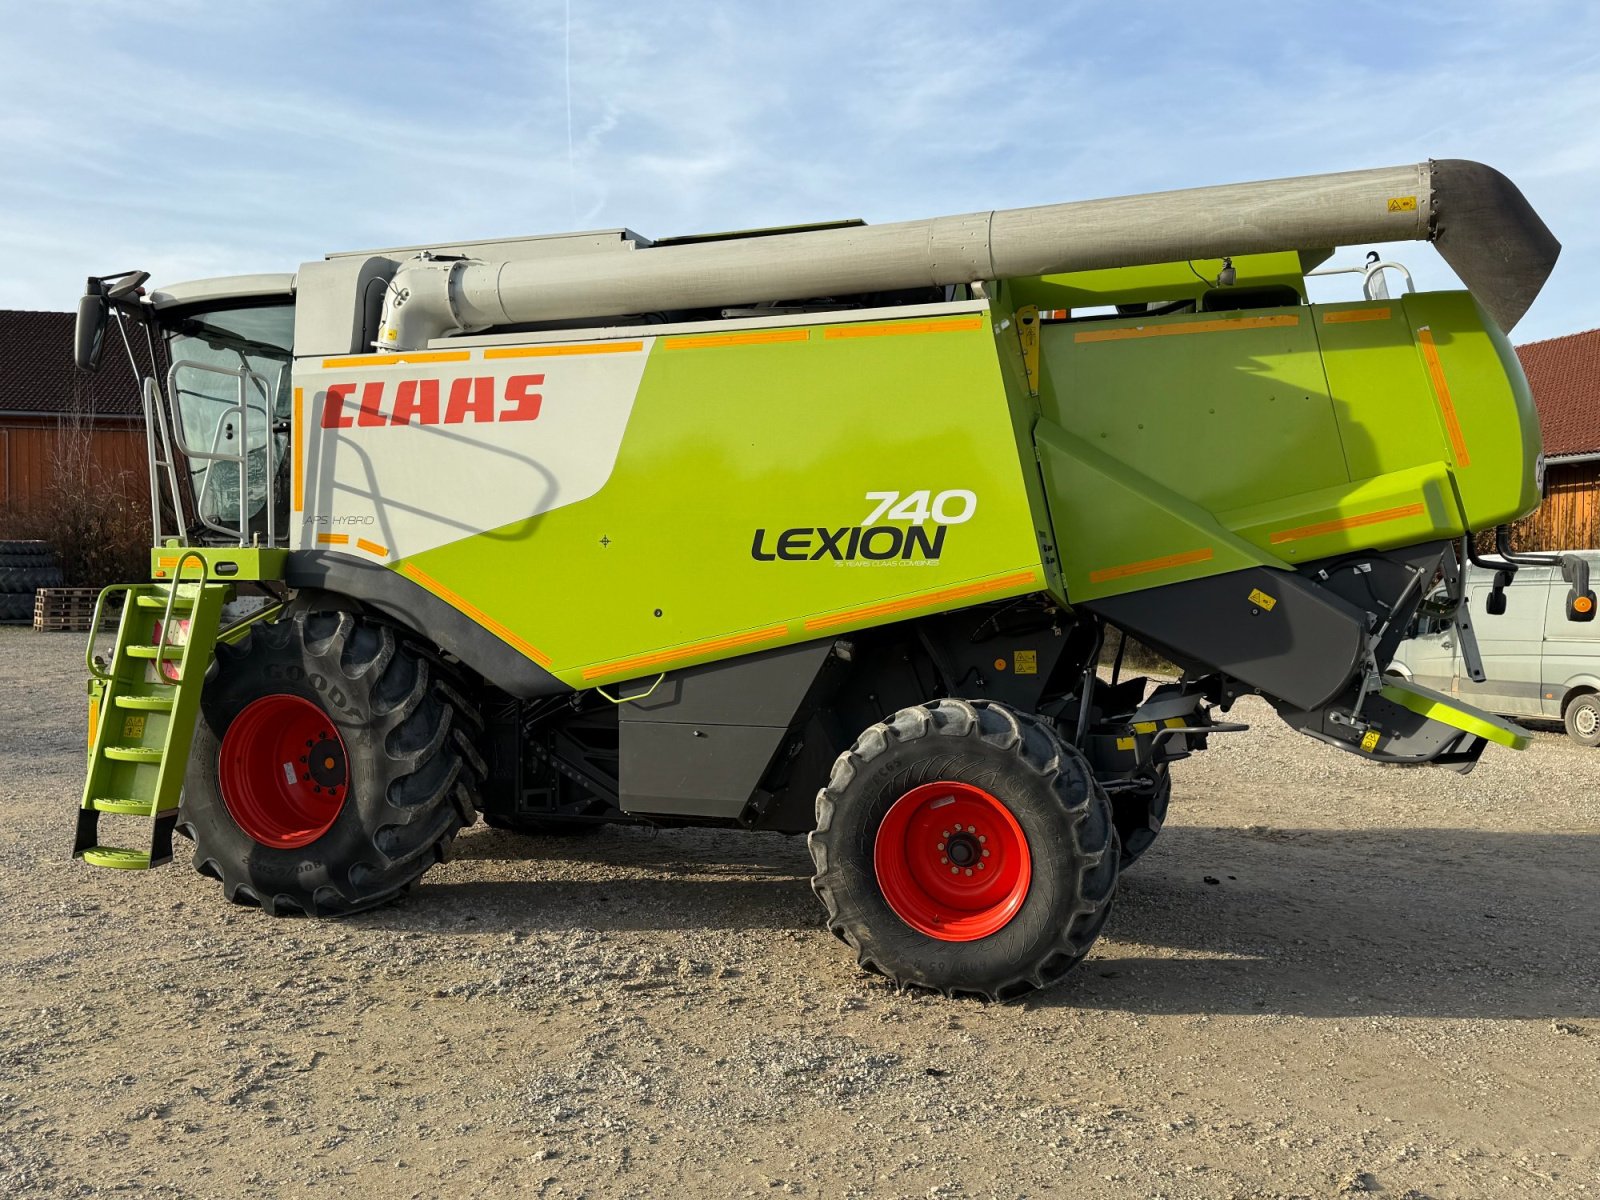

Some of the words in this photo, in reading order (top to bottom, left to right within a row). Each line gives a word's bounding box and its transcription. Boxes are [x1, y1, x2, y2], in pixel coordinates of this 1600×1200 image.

[320, 374, 545, 429] CLAAS
[303, 515, 329, 526] APS
[332, 515, 375, 525] HYBRID
[860, 489, 977, 526] 740
[751, 525, 947, 562] LEXION
